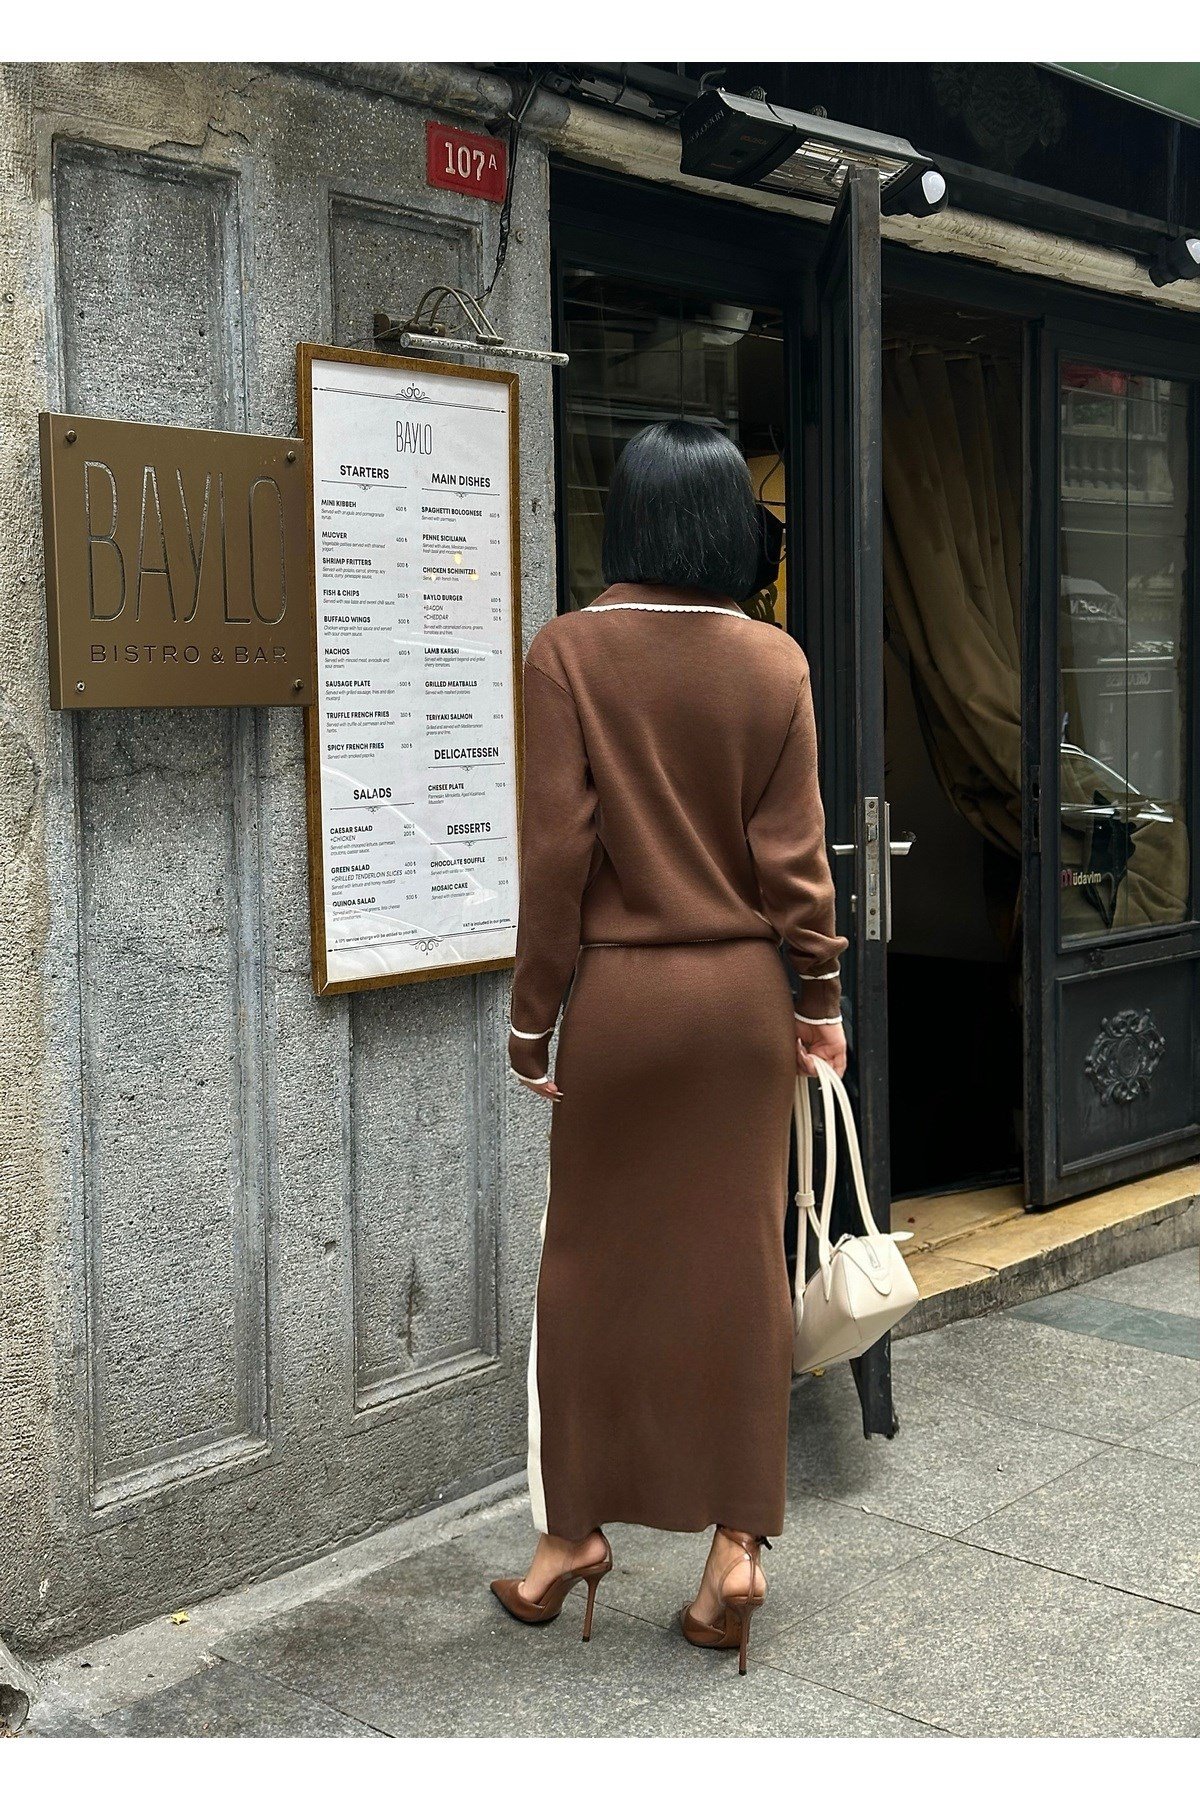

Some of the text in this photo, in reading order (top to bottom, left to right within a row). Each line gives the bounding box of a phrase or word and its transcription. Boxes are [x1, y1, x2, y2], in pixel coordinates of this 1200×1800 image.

[396, 420, 432, 455] BAYLO
[340, 465, 389, 479] STARTERS
[432, 473, 491, 488] MAIN DISHES
[336, 500, 357, 508] KIBBEH
[322, 531, 347, 539] MUCVER
[84, 460, 287, 625] BAYLO
[322, 557, 372, 566] SHRIMP FRITTERS
[90, 644, 288, 664] BISTRO & BAR
[434, 747, 499, 760] DELICATESSEN
[353, 787, 392, 800] SALADS
[447, 822, 491, 835] DESSERTS
[431, 857, 485, 868] CHOCOLATE SOUFFLE
[331, 864, 370, 874] GREEN SALAD
[355, 872, 385, 880] TENDERLOIN
[431, 884, 453, 892] MOSAIC
[332, 897, 375, 907] QUINOA SALAD
